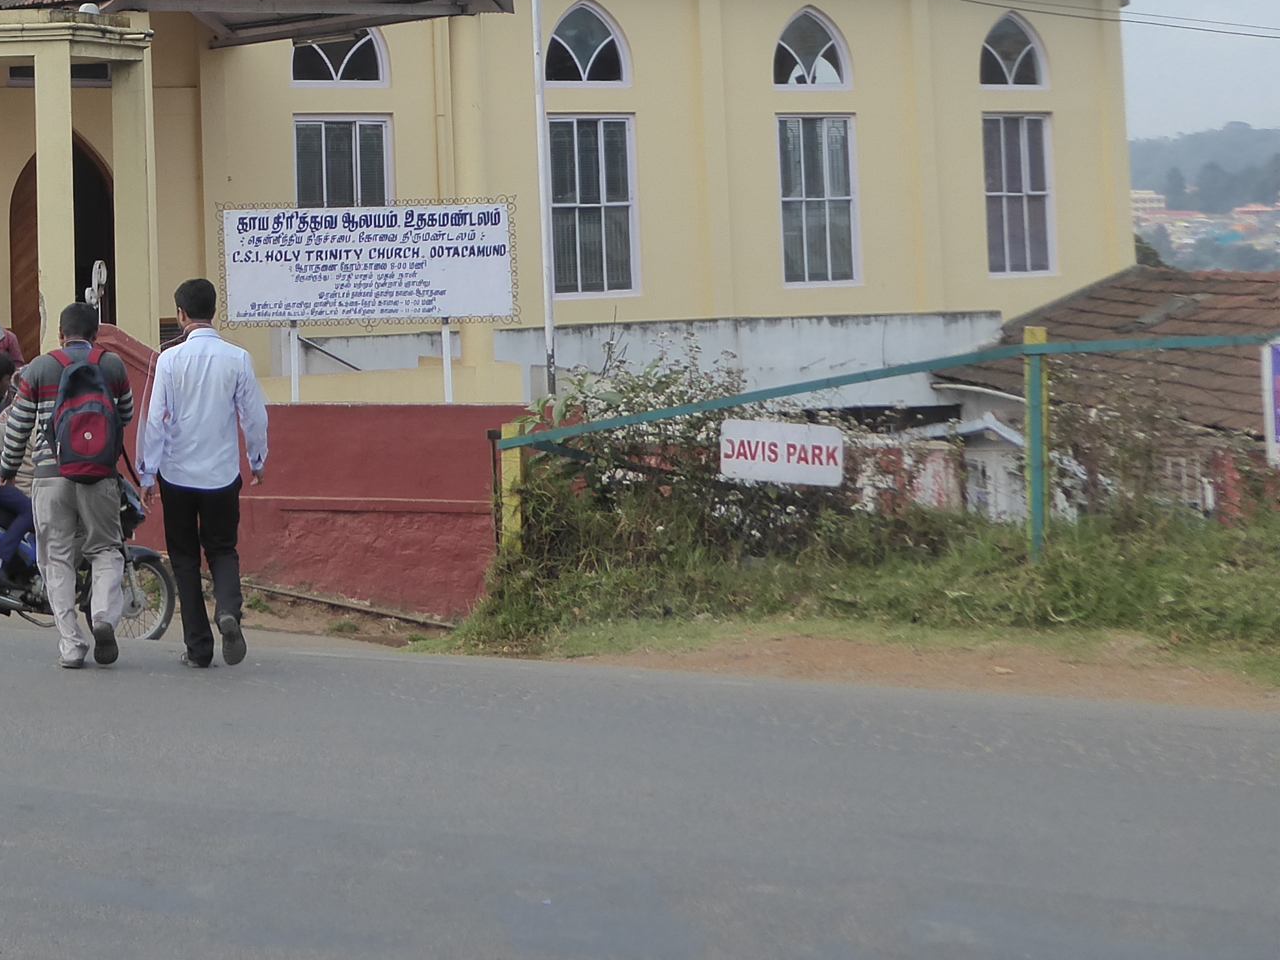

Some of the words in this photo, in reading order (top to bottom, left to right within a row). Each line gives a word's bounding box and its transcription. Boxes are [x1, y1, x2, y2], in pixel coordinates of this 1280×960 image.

[272, 211, 338, 233] திரித்துவ
[404, 208, 501, 230] உதகமண்டலம்
[358, 231, 398, 243] கோவை
[400, 229, 476, 244] திருமண்டலம்
[265, 249, 300, 262] HOLY
[305, 248, 363, 262] TRINITY
[429, 244, 507, 258] OOTACAMUND
[785, 442, 838, 467] PARK
